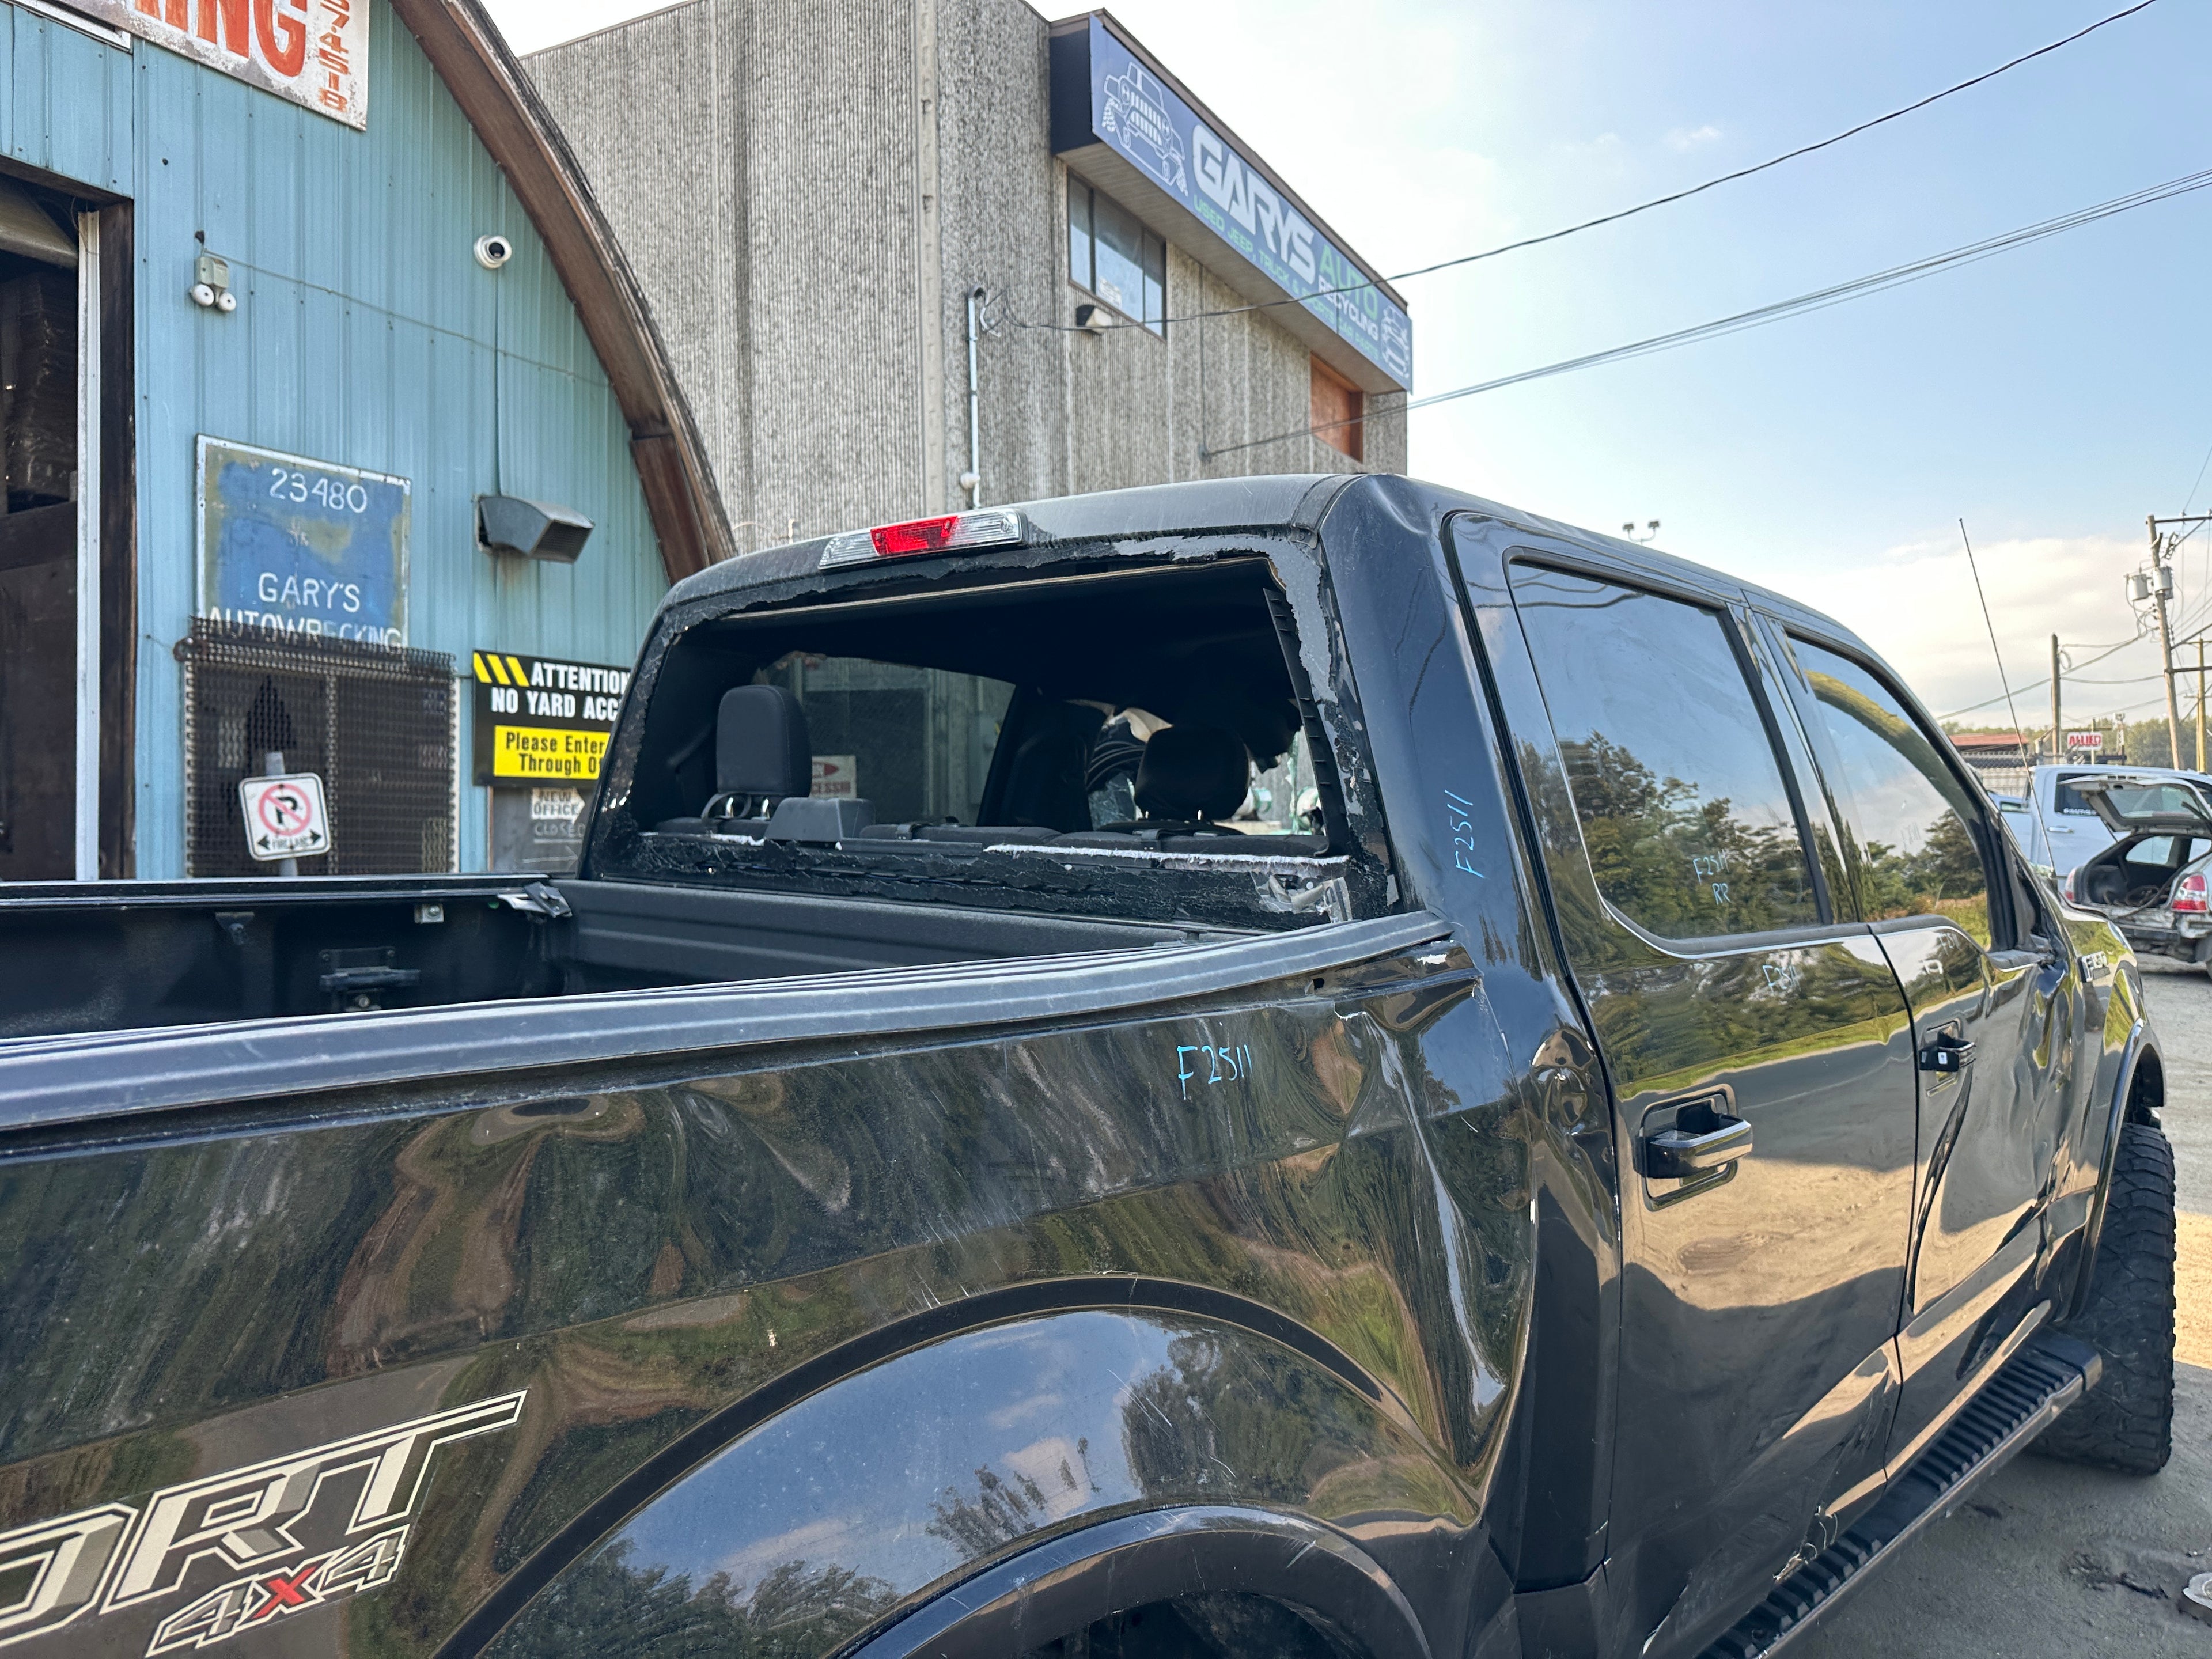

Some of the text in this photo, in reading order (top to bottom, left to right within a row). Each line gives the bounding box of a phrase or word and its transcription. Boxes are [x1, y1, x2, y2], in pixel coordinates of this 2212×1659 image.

[1192, 124, 1316, 285] GARYS
[1194, 194, 1225, 232] USED
[1258, 249, 1290, 288] TRUCK
[1320, 244, 1378, 320] AUTO
[1319, 273, 1379, 342] RECYCLING
[270, 467, 368, 513] 23480
[257, 572, 361, 613] GARY'S
[531, 661, 632, 695] ATTENTION
[491, 687, 622, 722] NO YARD ACC
[506, 731, 605, 754] Please Enter
[518, 753, 581, 776] Through
[533, 802, 579, 815] OFFICE
[1444, 789, 1490, 880] F2511
[1692, 849, 1729, 886] F2511
[1712, 883, 1730, 905] RR
[1177, 1044, 1253, 1100] F2511
